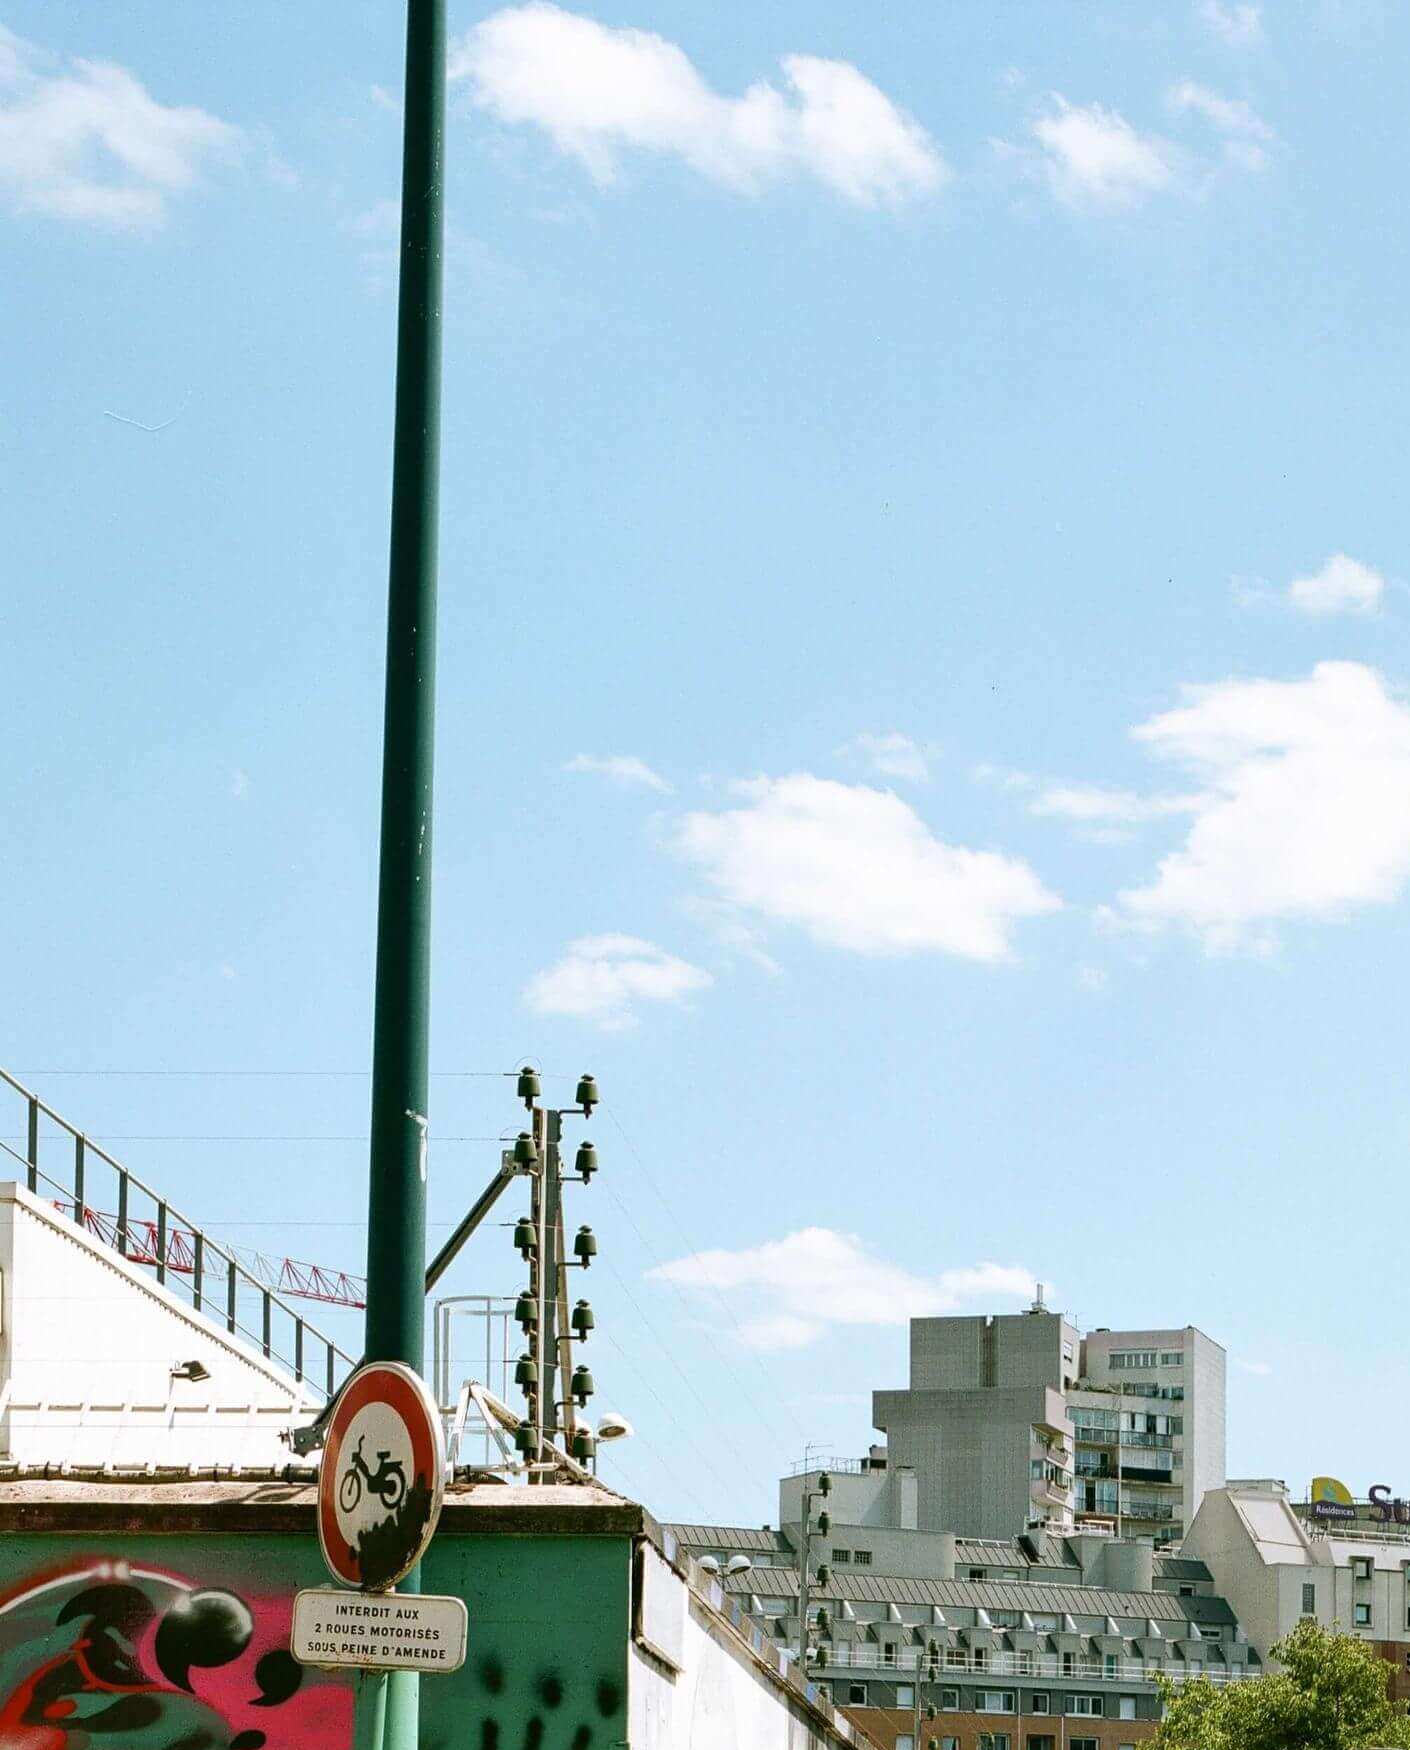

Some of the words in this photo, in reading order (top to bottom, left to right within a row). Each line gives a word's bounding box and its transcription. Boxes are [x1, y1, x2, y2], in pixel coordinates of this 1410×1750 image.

[336, 1605, 391, 1618] INTERDIT
[396, 1609, 420, 1620] AUX
[315, 1623, 322, 1634] 2
[326, 1623, 366, 1636] ROUES
[370, 1625, 440, 1640] MOTORISÉS
[307, 1641, 337, 1653] SOUS
[341, 1643, 378, 1656] PEINE
[382, 1645, 447, 1660] D'AMENDE
